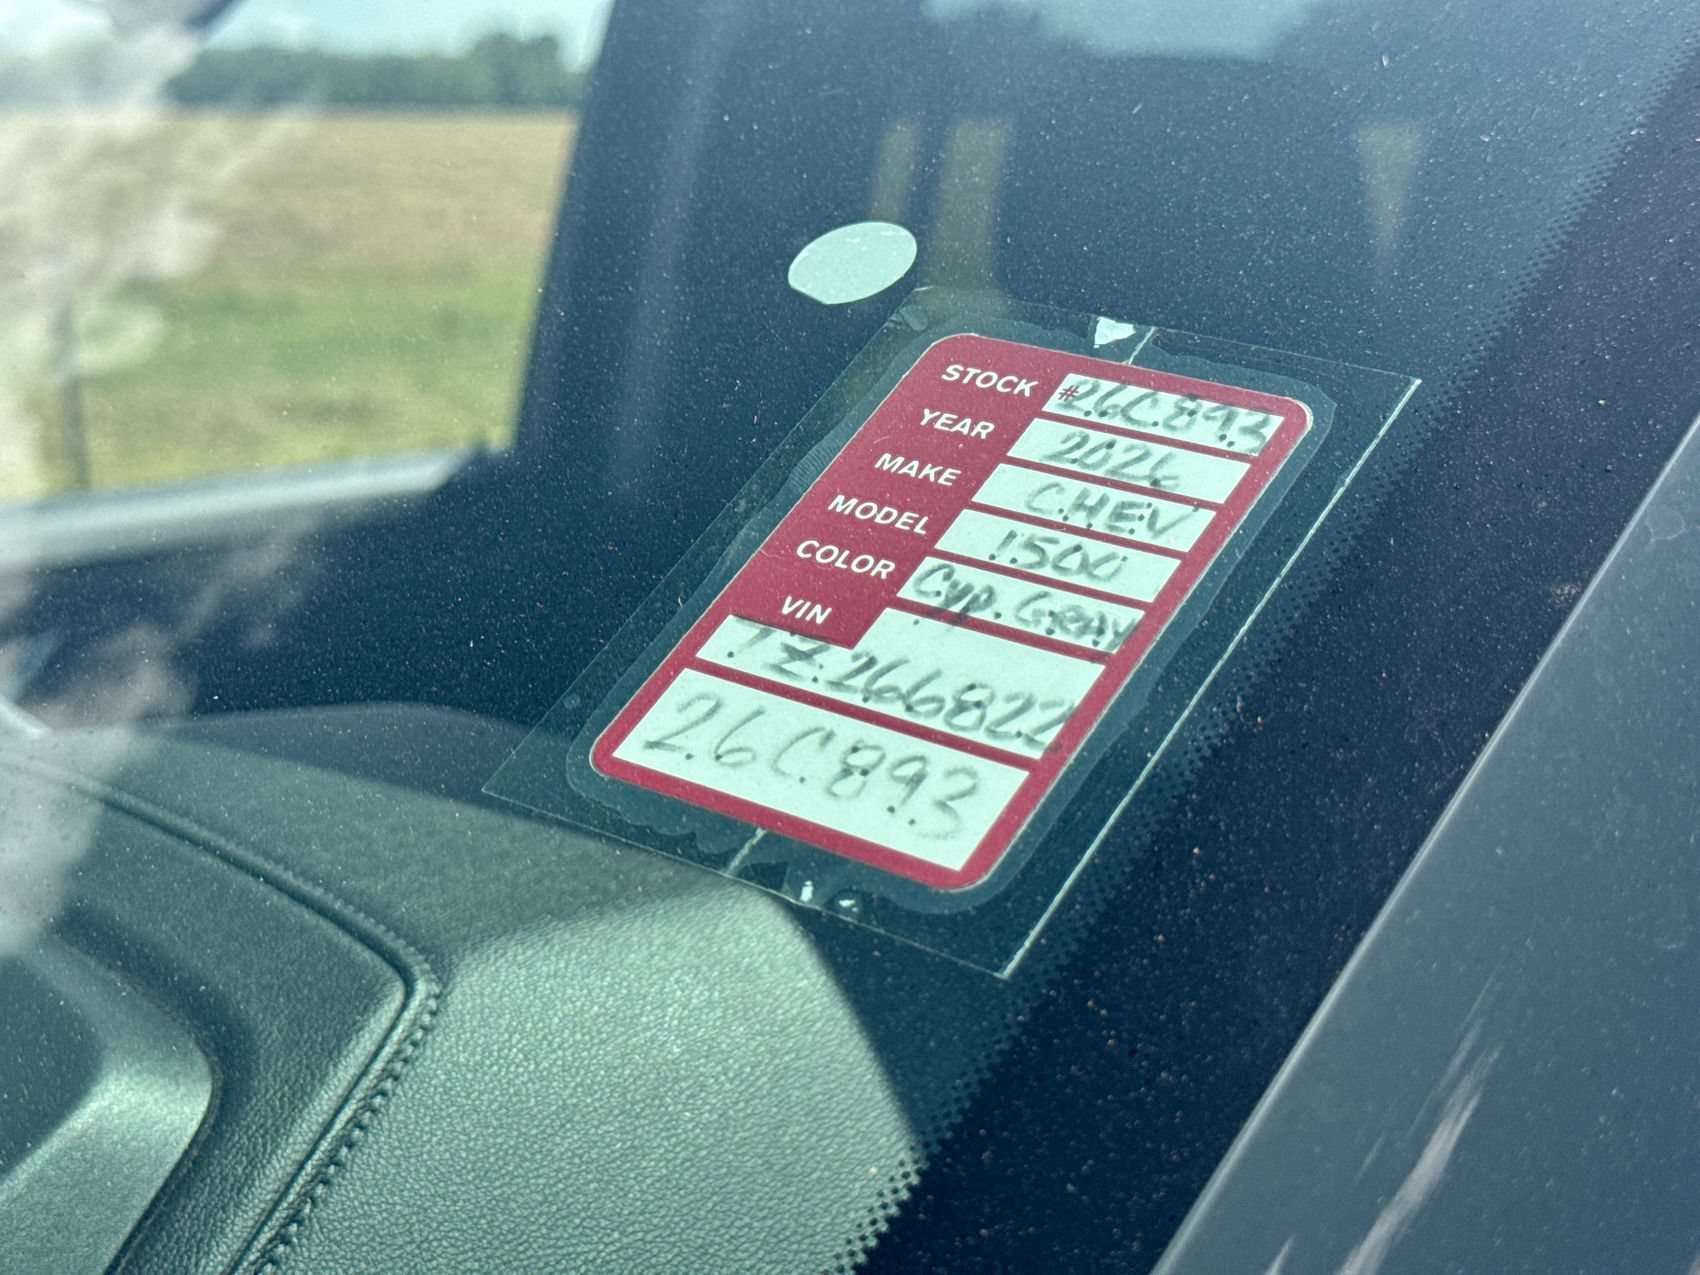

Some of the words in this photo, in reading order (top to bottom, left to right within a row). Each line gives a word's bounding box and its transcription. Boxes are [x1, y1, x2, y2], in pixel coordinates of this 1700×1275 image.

[941, 364, 1039, 397] STOCK
[920, 408, 995, 440] YEAR
[874, 453, 962, 486] MAKE
[1041, 430, 1180, 490] 2026
[827, 494, 929, 535] MODEL
[796, 540, 896, 580] COLOR
[992, 529, 1122, 582] 1500
[781, 594, 832, 624] VIN
